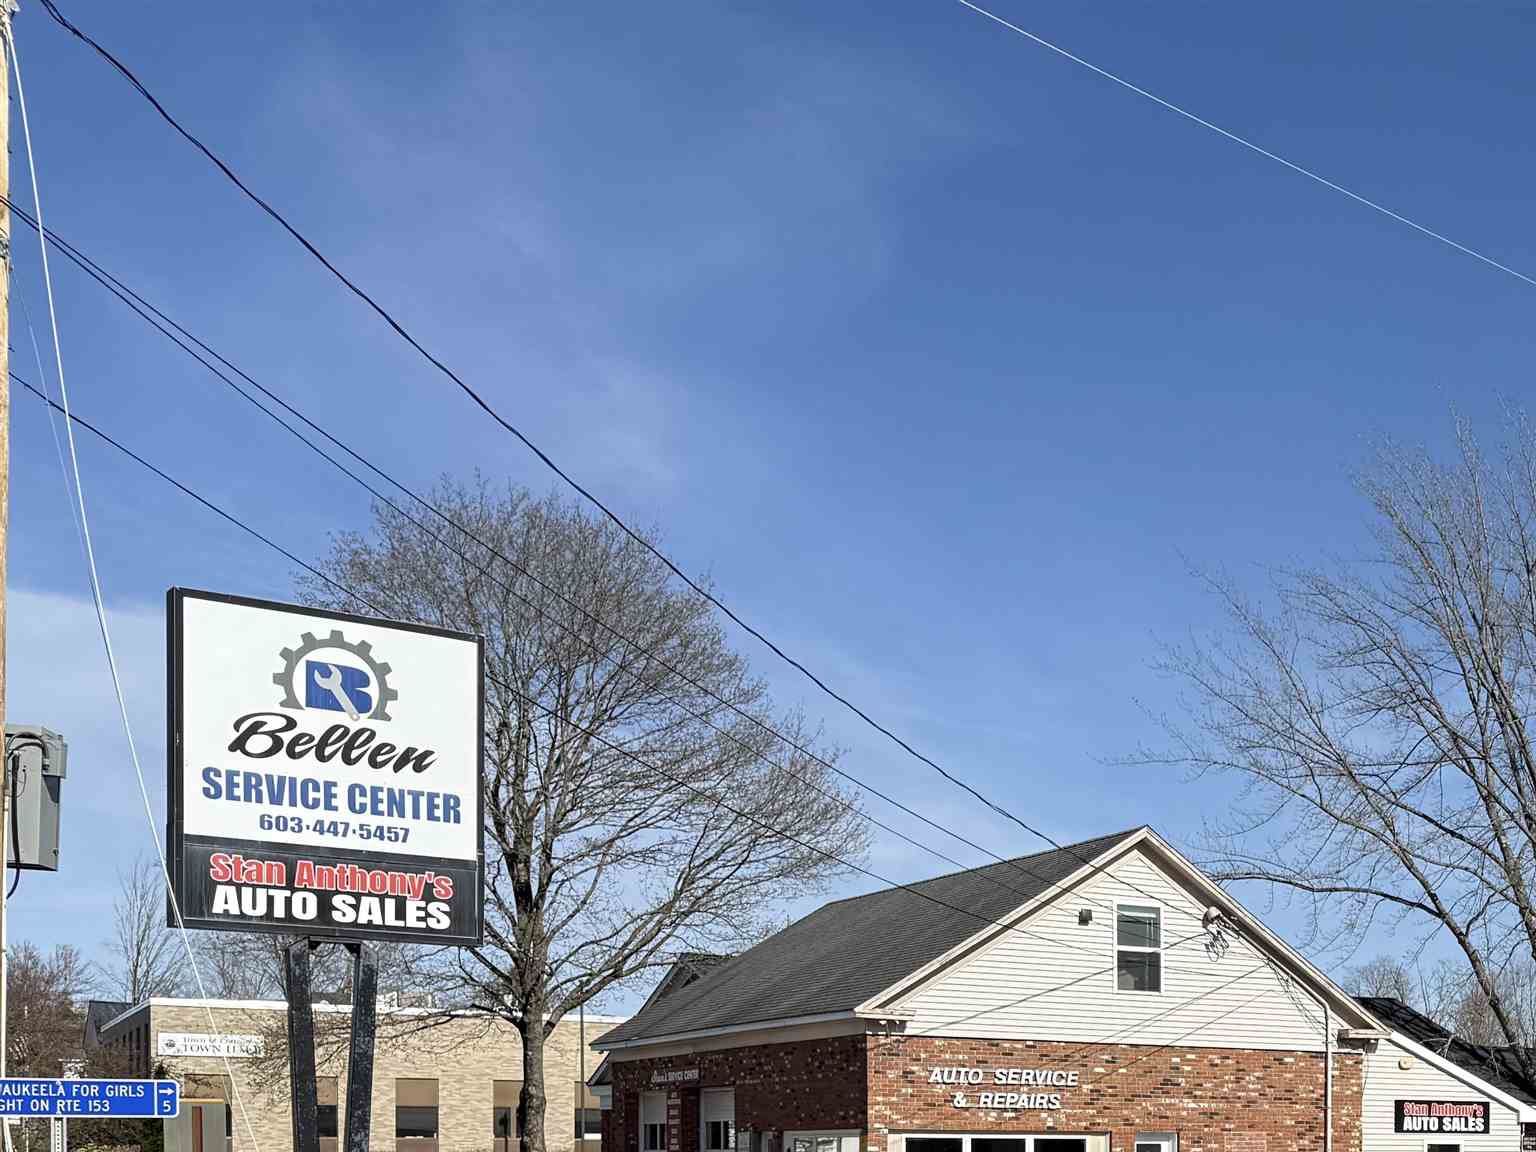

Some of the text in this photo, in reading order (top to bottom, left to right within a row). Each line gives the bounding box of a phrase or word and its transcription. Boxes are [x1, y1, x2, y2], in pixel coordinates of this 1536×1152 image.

[228, 711, 439, 774] Bellen
[201, 766, 462, 825] SERVICE CENTER
[210, 852, 454, 901] Stan Anthony's
[211, 884, 452, 930] AUTO SALES
[928, 1068, 1079, 1087] AUTO SERVICE
[0, 1084, 145, 1097] AUKEELA FOR GIRLS
[30, 1100, 49, 1112] ON
[57, 1100, 81, 1112] RTE
[88, 1101, 110, 1112] 153
[163, 1100, 171, 1112] 5
[953, 1092, 1061, 1109] & REPAIRS
[1403, 1102, 1429, 1116] Stan
[1403, 1116, 1485, 1132] AUTO SALES
